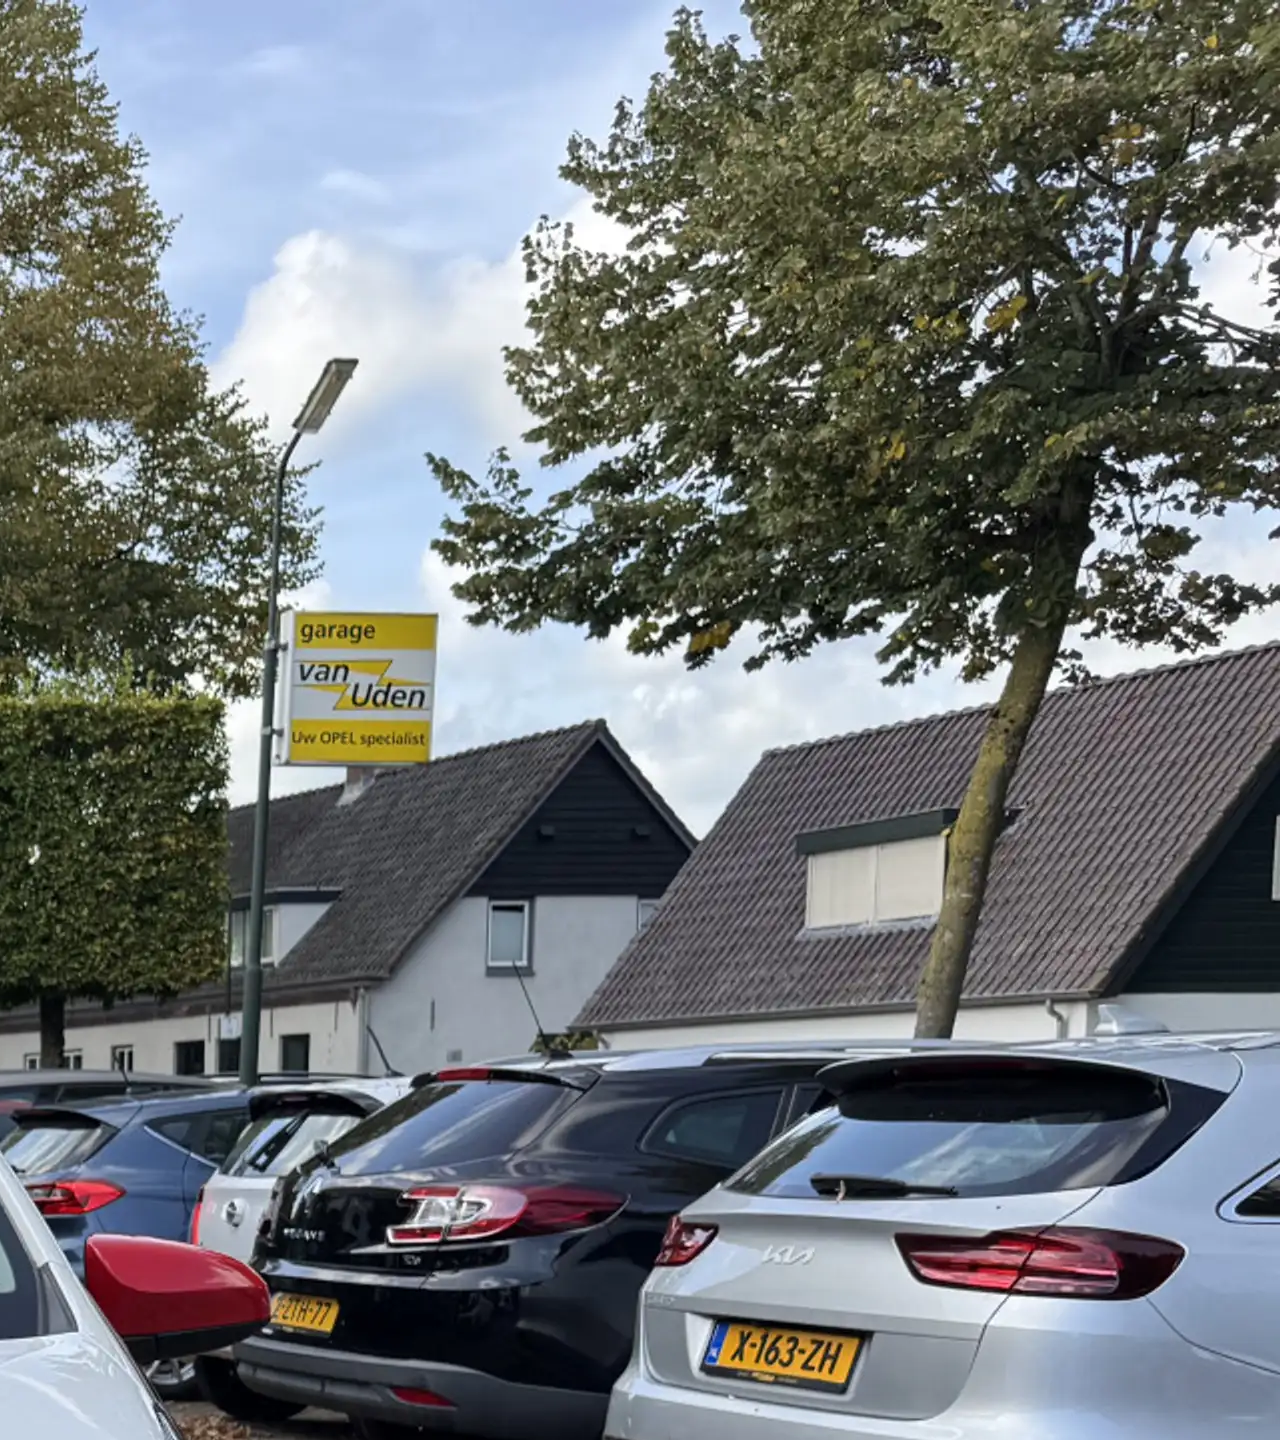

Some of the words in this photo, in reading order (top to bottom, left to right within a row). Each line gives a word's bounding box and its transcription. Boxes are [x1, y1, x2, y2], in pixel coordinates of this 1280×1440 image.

[300, 622, 376, 644] garage
[299, 663, 350, 683] van
[351, 682, 426, 709] Uden
[292, 731, 316, 744] Uw
[320, 731, 356, 745] OPEL
[360, 731, 426, 748] specialist
[730, 1328, 844, 1375] X-163-ZH
